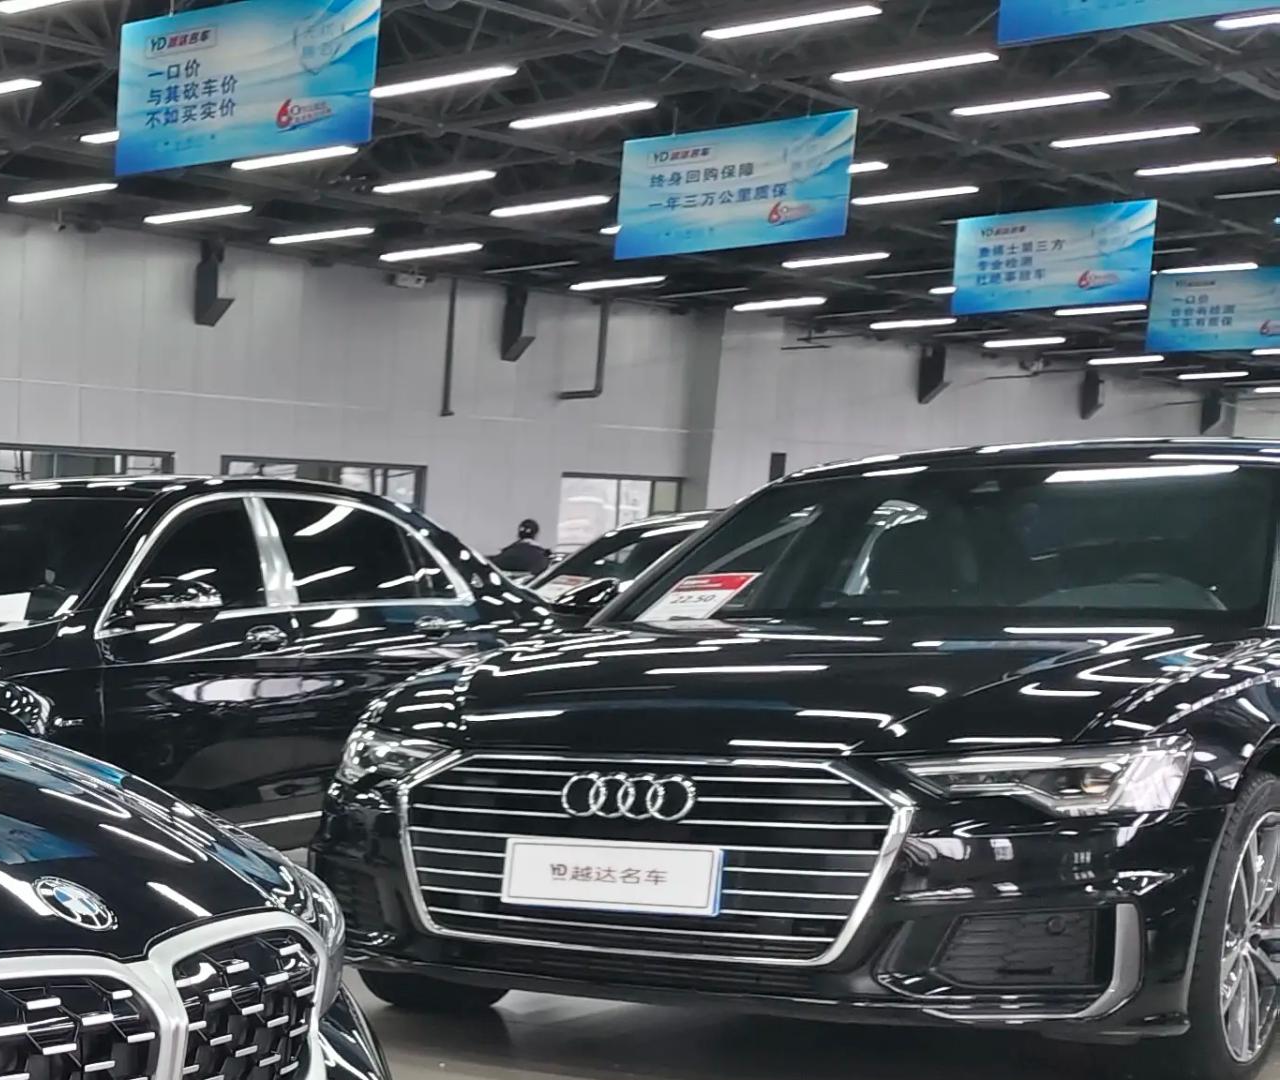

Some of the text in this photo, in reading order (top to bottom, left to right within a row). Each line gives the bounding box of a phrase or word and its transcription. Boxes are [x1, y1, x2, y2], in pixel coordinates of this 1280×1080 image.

[147, 59, 200, 80] 一口价
[146, 75, 238, 106] 与其砍车价
[145, 98, 236, 128] 不如买实价
[649, 163, 754, 188] 终身回购保障
[648, 183, 788, 210] 一年三万公里质保
[570, 865, 668, 886] 越达名车
